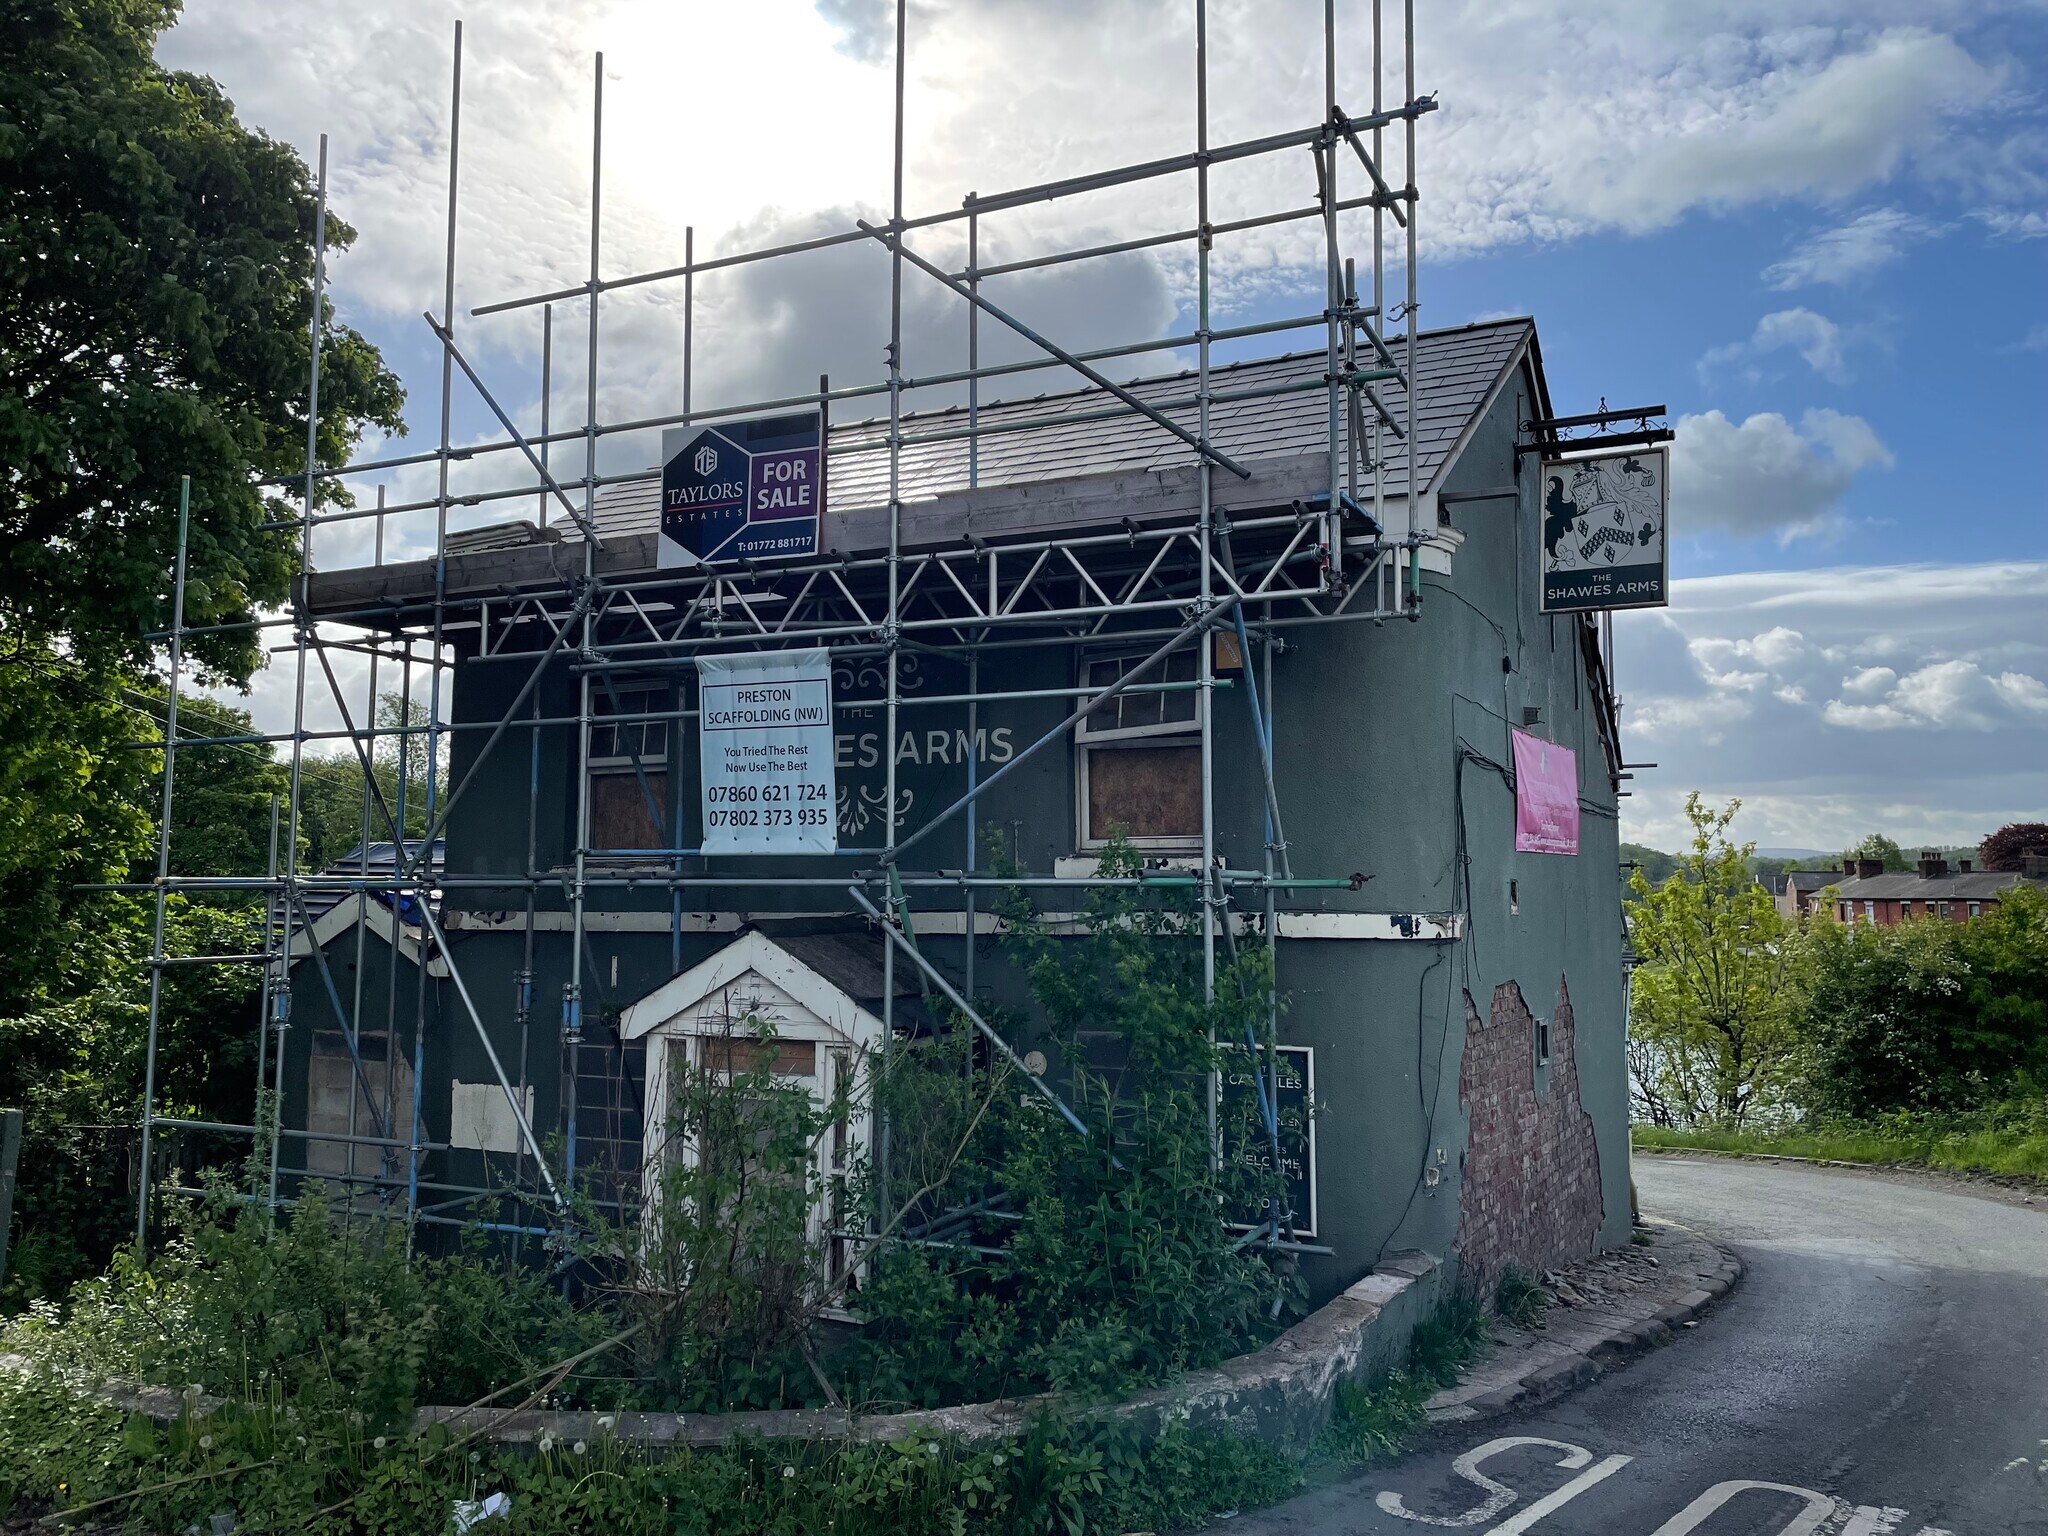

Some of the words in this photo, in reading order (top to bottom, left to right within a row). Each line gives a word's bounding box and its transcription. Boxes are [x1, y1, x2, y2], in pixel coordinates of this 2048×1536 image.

[763, 459, 807, 484] FOR
[668, 481, 744, 505] TAYLORS
[757, 484, 811, 510] SALE
[666, 508, 744, 524] ESTATES
[738, 542, 746, 552] T:
[747, 538, 776, 551] 01772
[778, 536, 813, 549] 881717
[1592, 573, 1612, 582] THE
[1548, 584, 1612, 600] SHAWES
[1615, 580, 1659, 595] ARMS
[737, 688, 792, 704] PRESTON
[708, 709, 791, 725] SCAFFOLDING
[794, 707, 823, 722] (NW)
[724, 747, 741, 757] You
[743, 746, 767, 756] Tried
[768, 745, 786, 756] The
[788, 744, 809, 755] Rest
[896, 727, 1014, 766] ARMS
[725, 762, 746, 773] Now
[748, 762, 767, 772] Use
[768, 761, 785, 771] The
[787, 761, 808, 771] Best
[708, 786, 758, 803] 07860
[762, 785, 790, 802] 621
[797, 784, 828, 801] 724
[709, 810, 759, 827] 07802
[763, 809, 793, 826] 373
[797, 808, 828, 826] 935
[1231, 1153, 1301, 1170] WELCME
